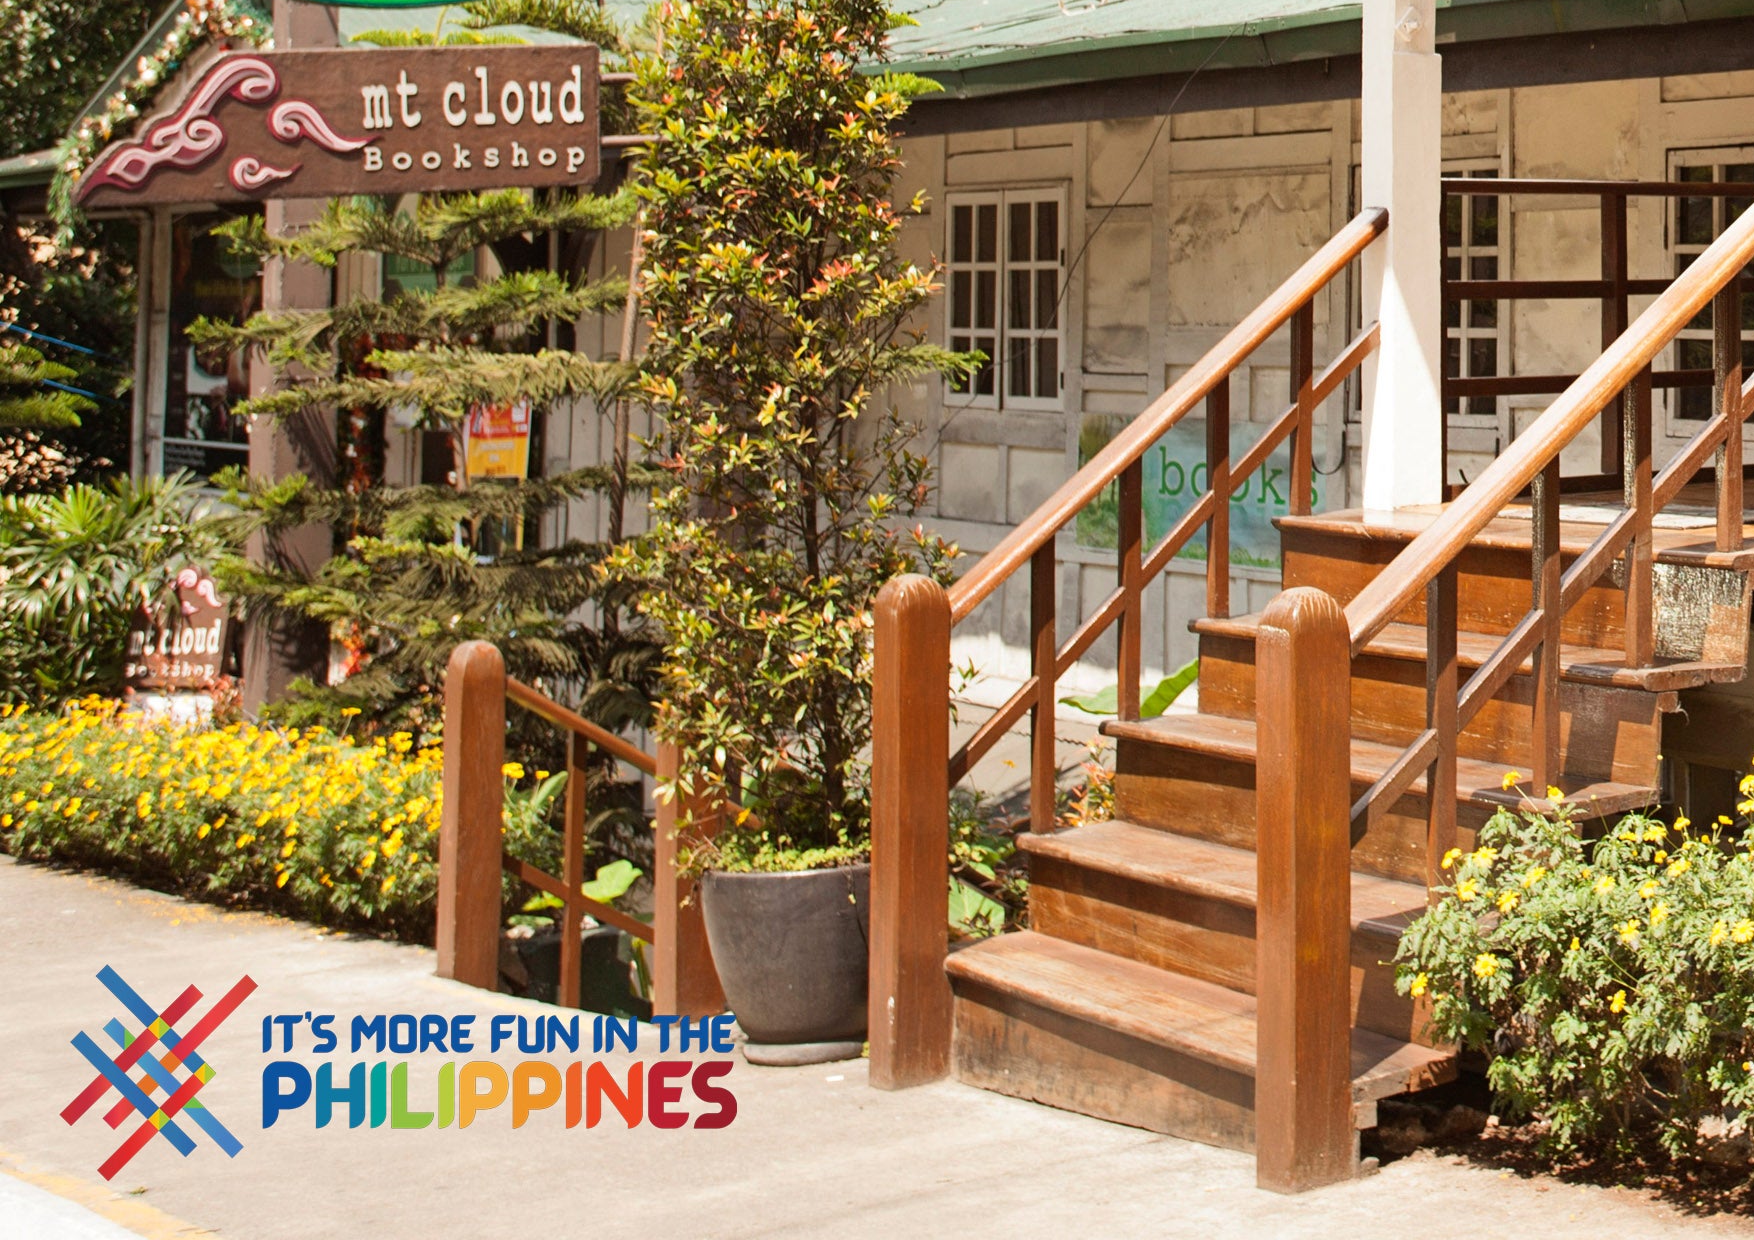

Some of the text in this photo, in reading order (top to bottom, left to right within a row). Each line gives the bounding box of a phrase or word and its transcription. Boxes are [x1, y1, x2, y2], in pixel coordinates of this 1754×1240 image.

[361, 64, 585, 129] mt cloud
[363, 141, 586, 173] Bookshop
[159, 618, 222, 656] cloud
